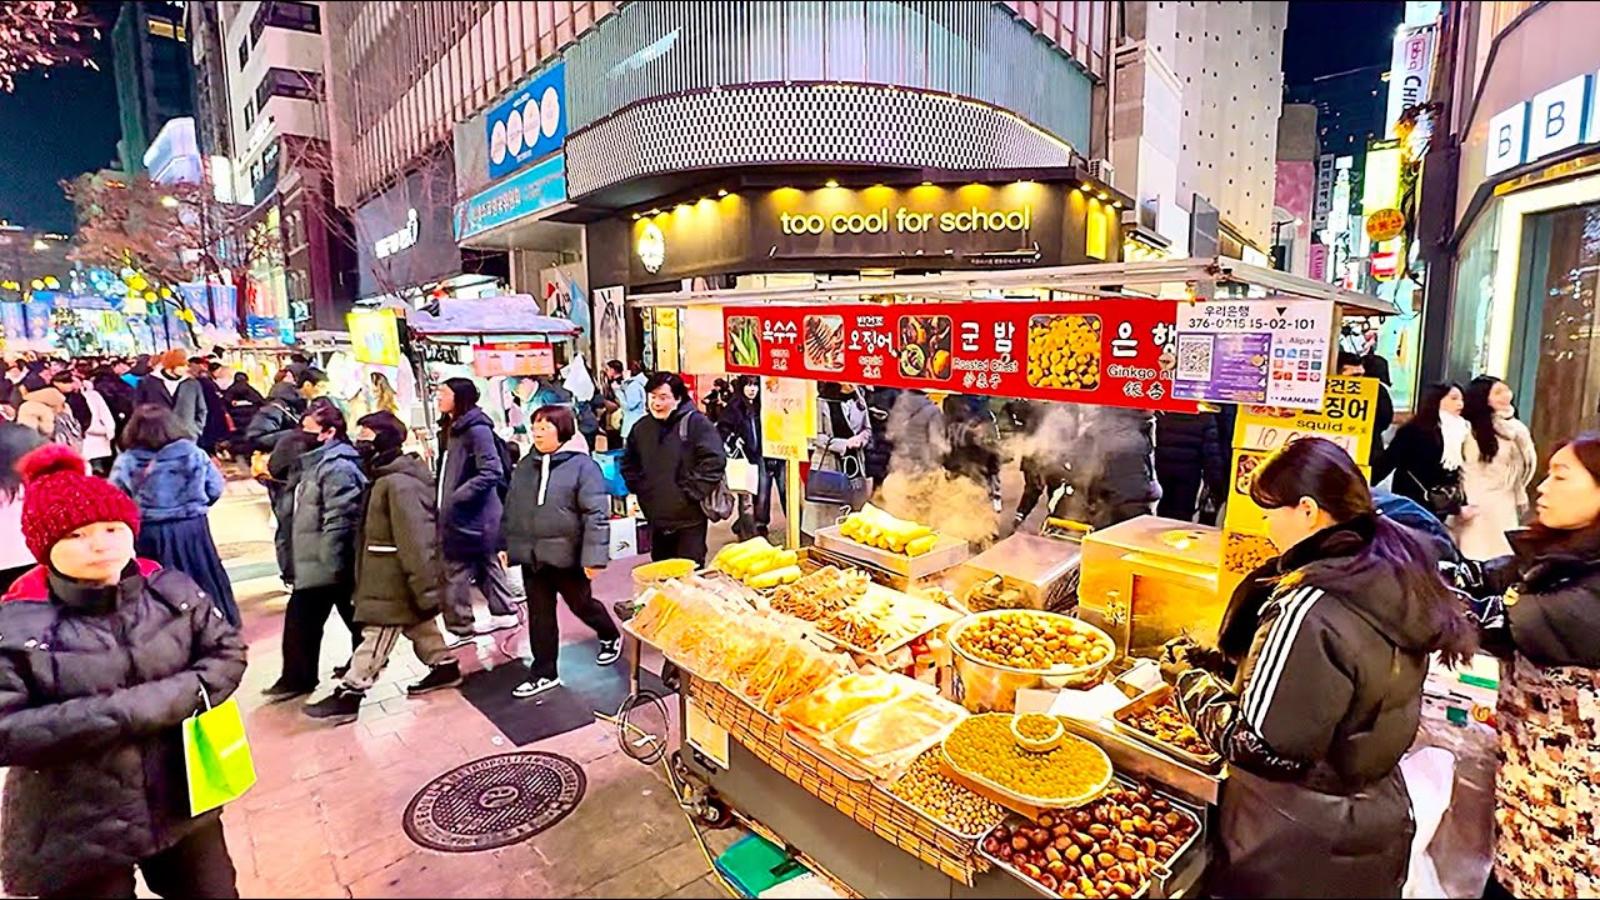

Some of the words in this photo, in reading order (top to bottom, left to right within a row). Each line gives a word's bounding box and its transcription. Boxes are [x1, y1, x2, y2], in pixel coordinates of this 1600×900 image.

[1545, 101, 1565, 139] B
[780, 211, 824, 235] too
[831, 208, 888, 234] cool
[896, 207, 934, 232] for
[940, 205, 1031, 232] school
[1204, 305, 1250, 318] 우리은행
[762, 319, 798, 344] 옥수수
[849, 330, 897, 356] 오징어
[1107, 364, 1156, 380] Ginkgo
[1302, 396, 1369, 421] 징어
[1296, 420, 1343, 432] squid
